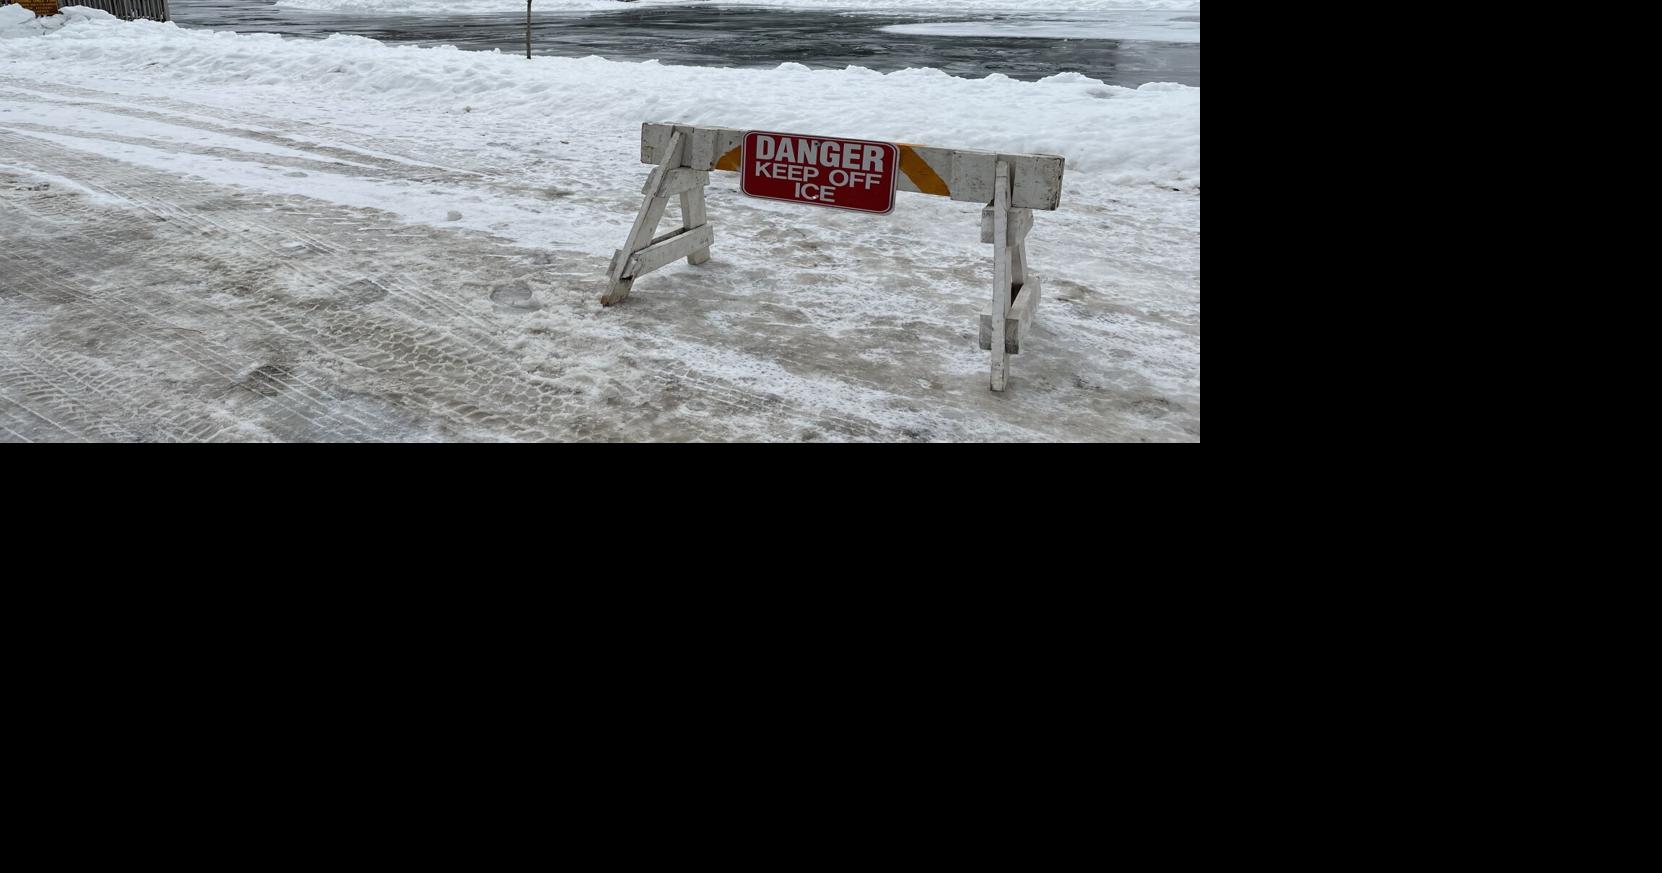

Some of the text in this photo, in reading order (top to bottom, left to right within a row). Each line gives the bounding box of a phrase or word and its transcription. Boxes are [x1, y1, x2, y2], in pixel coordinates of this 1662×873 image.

[756, 135, 884, 172] DANGER
[755, 161, 882, 190] KEEP OFF
[795, 182, 836, 202] ICE
